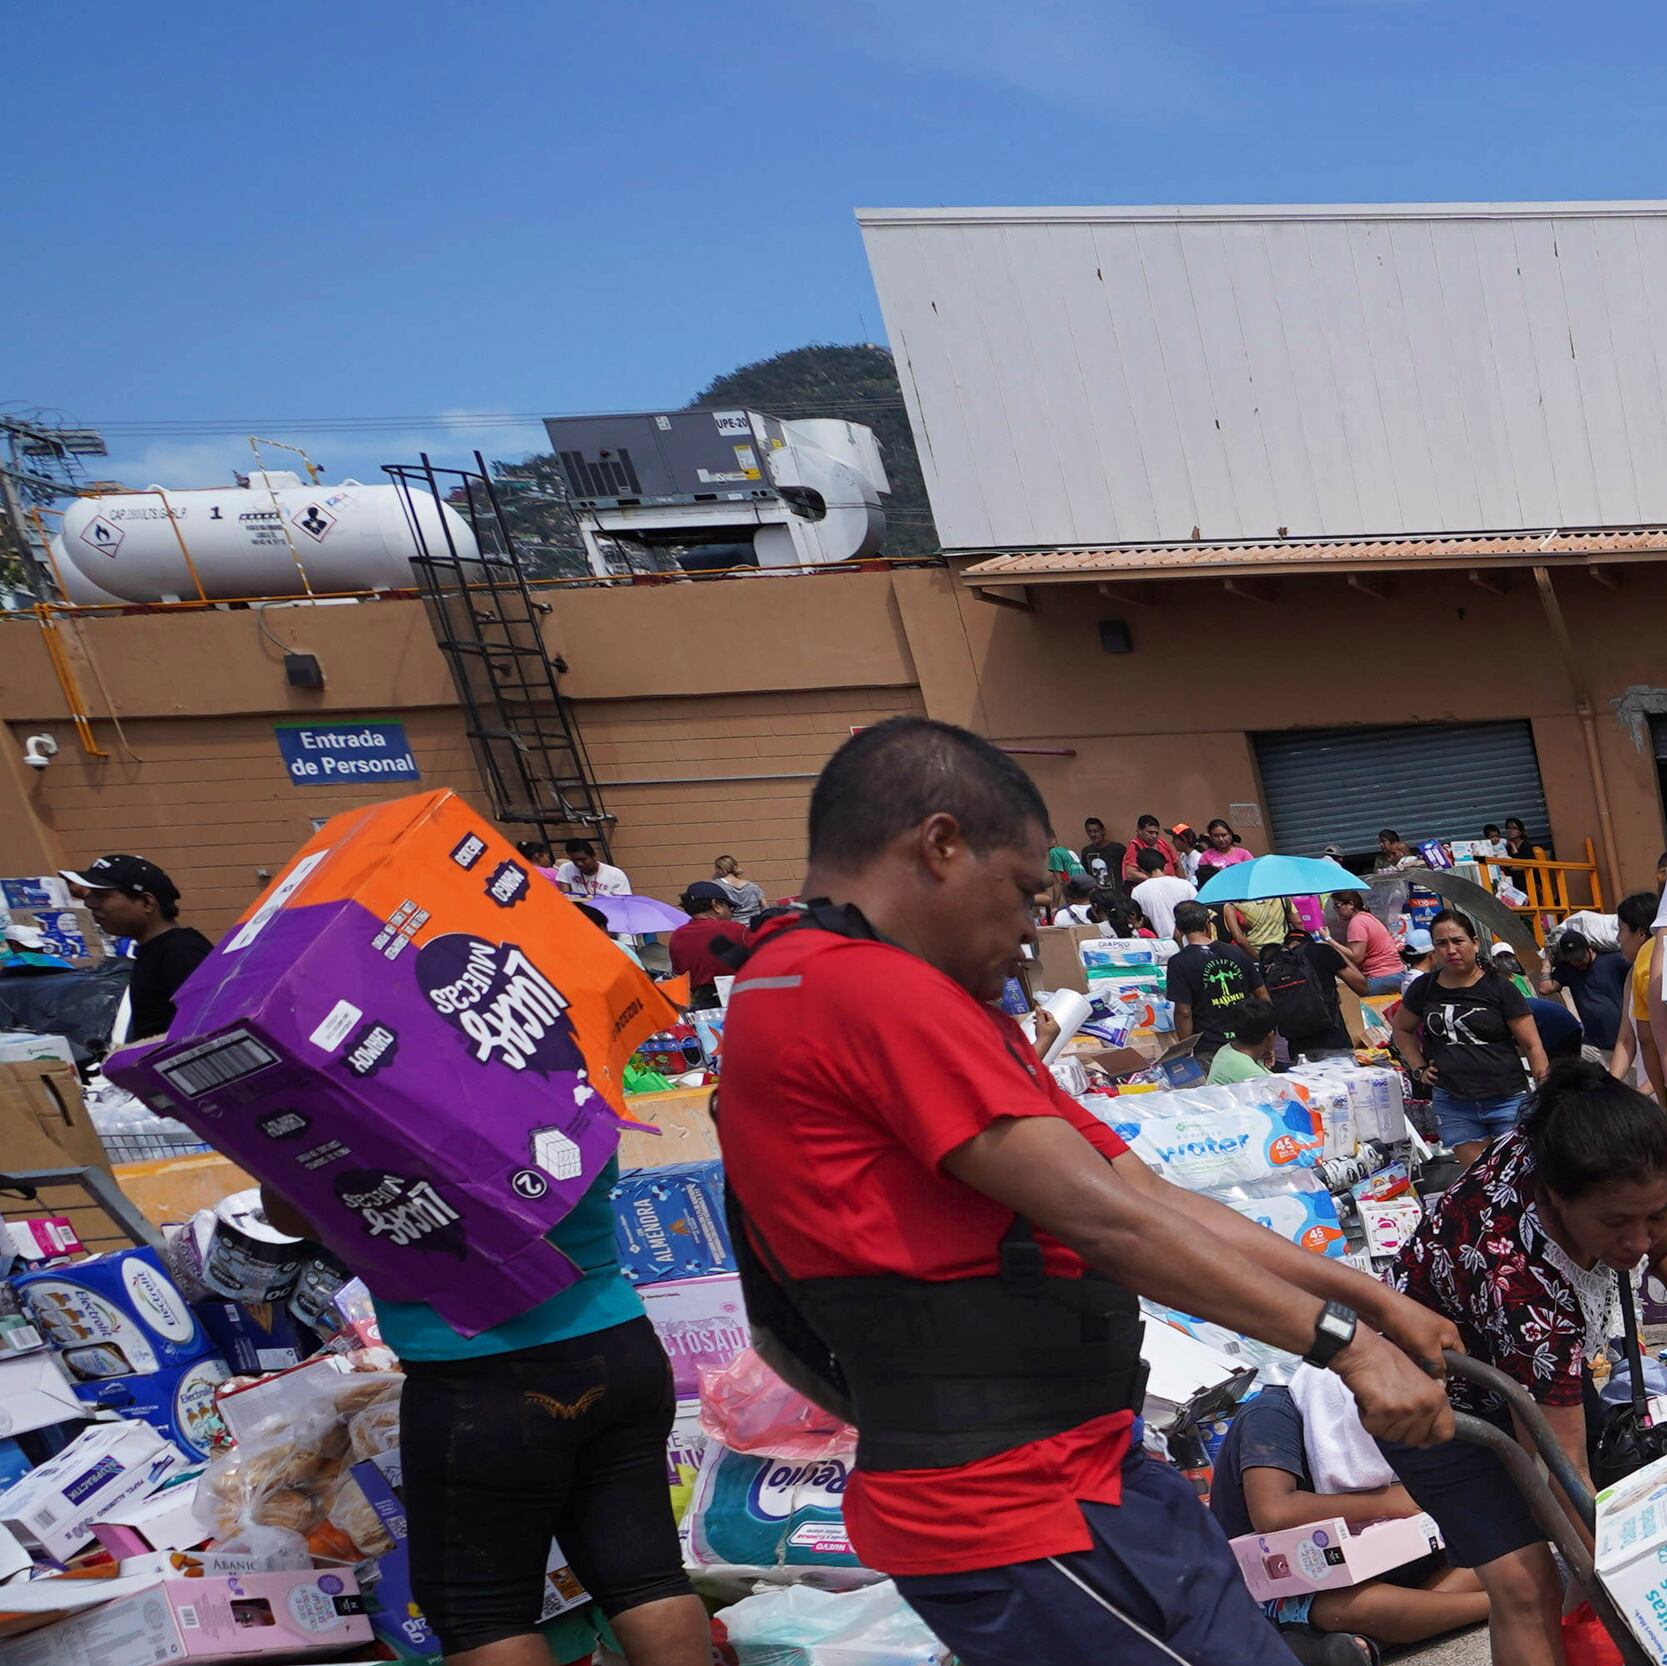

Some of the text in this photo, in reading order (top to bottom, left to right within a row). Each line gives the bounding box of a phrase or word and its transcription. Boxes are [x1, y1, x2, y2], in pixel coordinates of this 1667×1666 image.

[716, 416, 747, 430] UPE-20
[210, 506, 223, 519] 1
[301, 731, 386, 750] Entrada
[292, 754, 414, 777] de Personal
[348, 1029, 396, 1074] CHAMOY
[1154, 1133, 1249, 1164] water
[1275, 1139, 1292, 1151] 45
[514, 1173, 543, 1197] 2
[638, 1196, 675, 1264] ALMENDRA
[1309, 1228, 1324, 1240] 45
[75, 1290, 113, 1338] Electrolit
[816, 1543, 846, 1551] NUEVO
